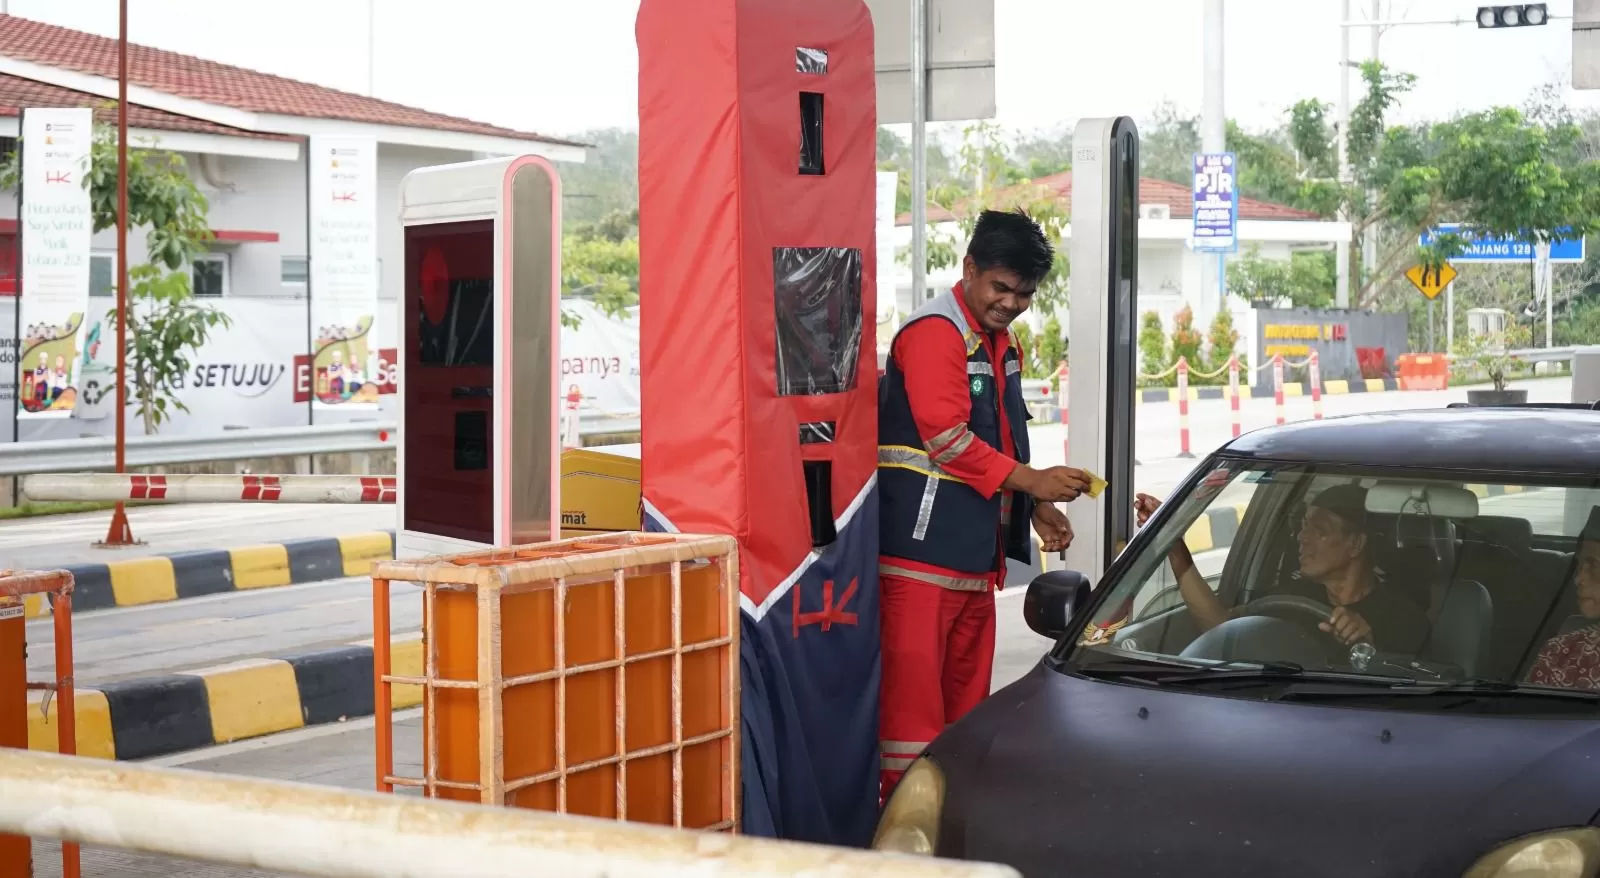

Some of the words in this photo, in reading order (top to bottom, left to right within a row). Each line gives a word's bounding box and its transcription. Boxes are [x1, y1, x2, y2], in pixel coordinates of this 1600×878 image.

[46, 170, 71, 184] HK
[1195, 172, 1232, 194] PJR
[1513, 244, 1530, 255] 128
[193, 363, 274, 388] SETUJU
[561, 513, 586, 525] mat
[792, 576, 858, 640] HK
